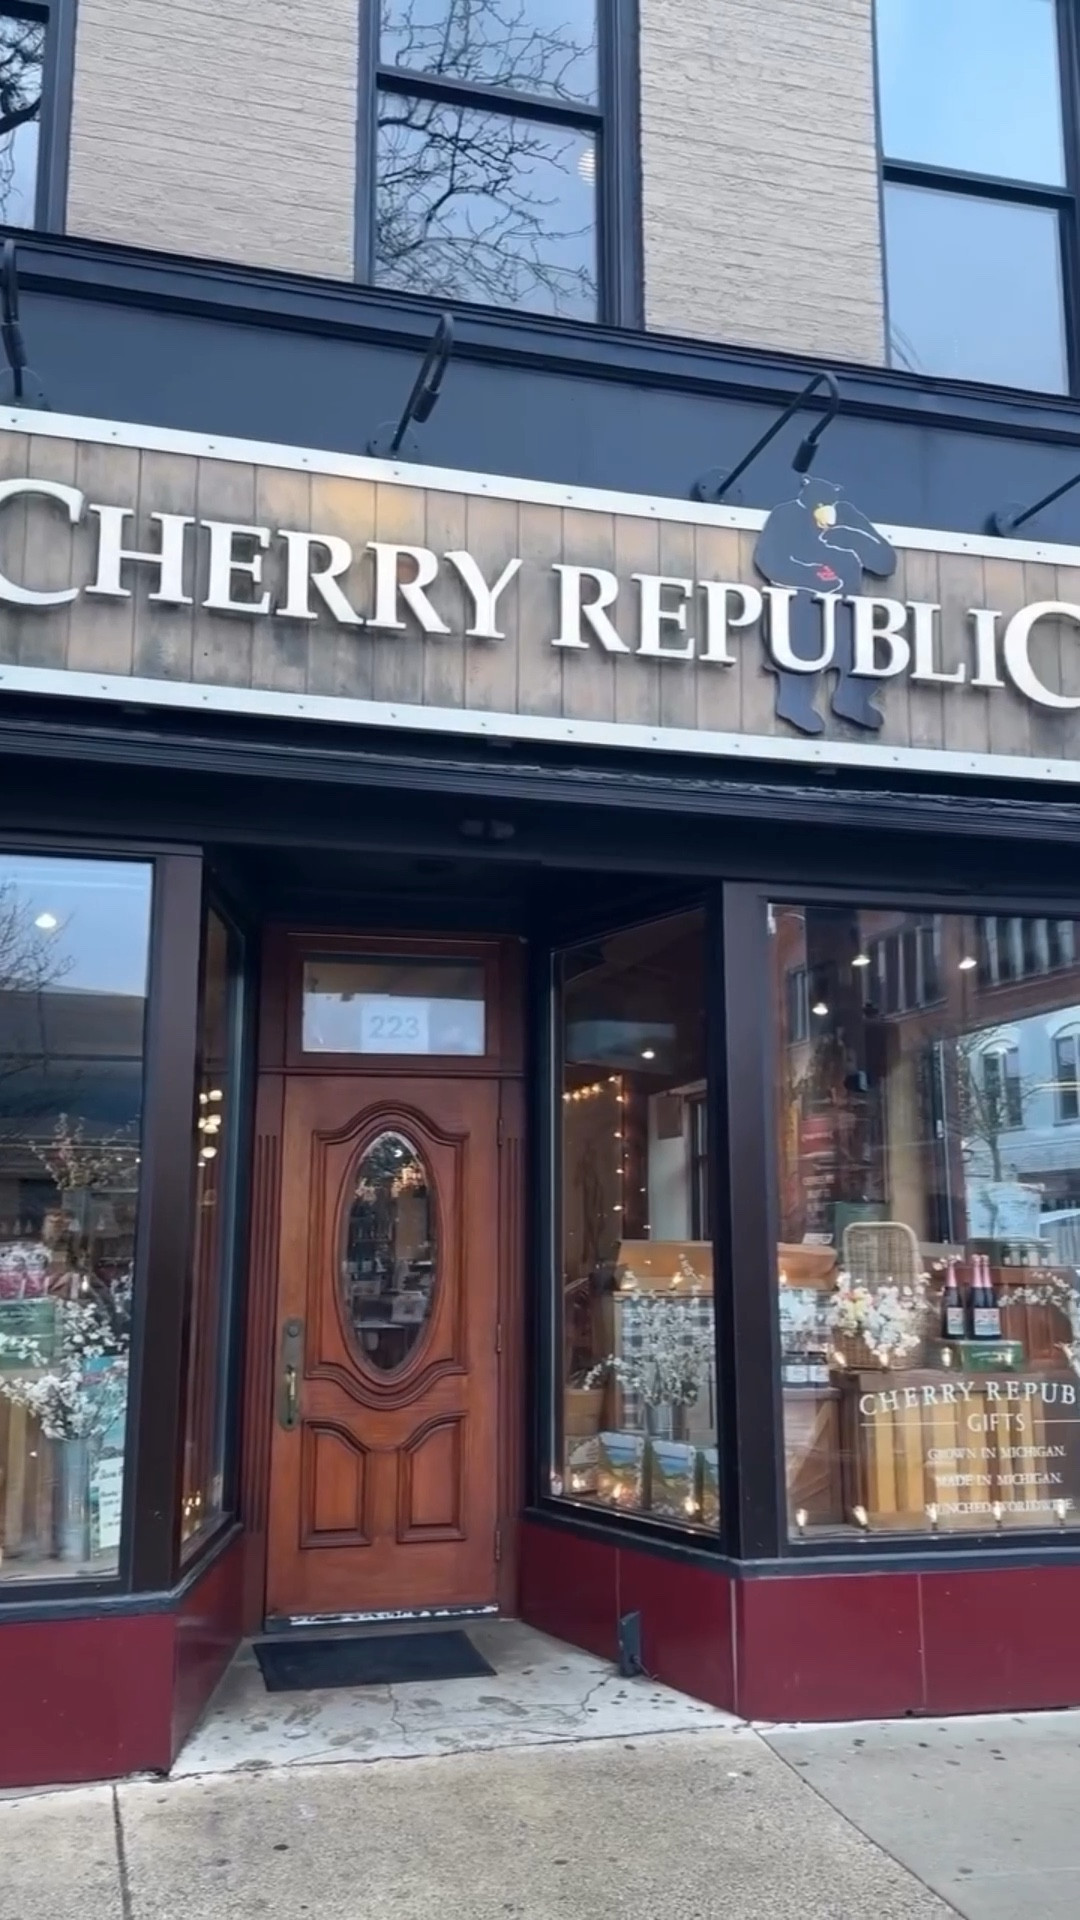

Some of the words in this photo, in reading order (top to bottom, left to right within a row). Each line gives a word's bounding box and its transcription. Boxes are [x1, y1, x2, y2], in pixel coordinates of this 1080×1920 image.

[0, 477, 522, 640] CHERRY
[551, 563, 1080, 709] REPUBLIC
[369, 1015, 420, 1039] 223
[859, 1381, 975, 1416] CHERRY
[985, 1380, 1077, 1405] REPUB
[967, 1413, 1026, 1433] GIFTS
[927, 1447, 977, 1461] GROWN
[981, 1446, 997, 1459] IN
[935, 1474, 973, 1488] MADE
[976, 1474, 993, 1487] IN
